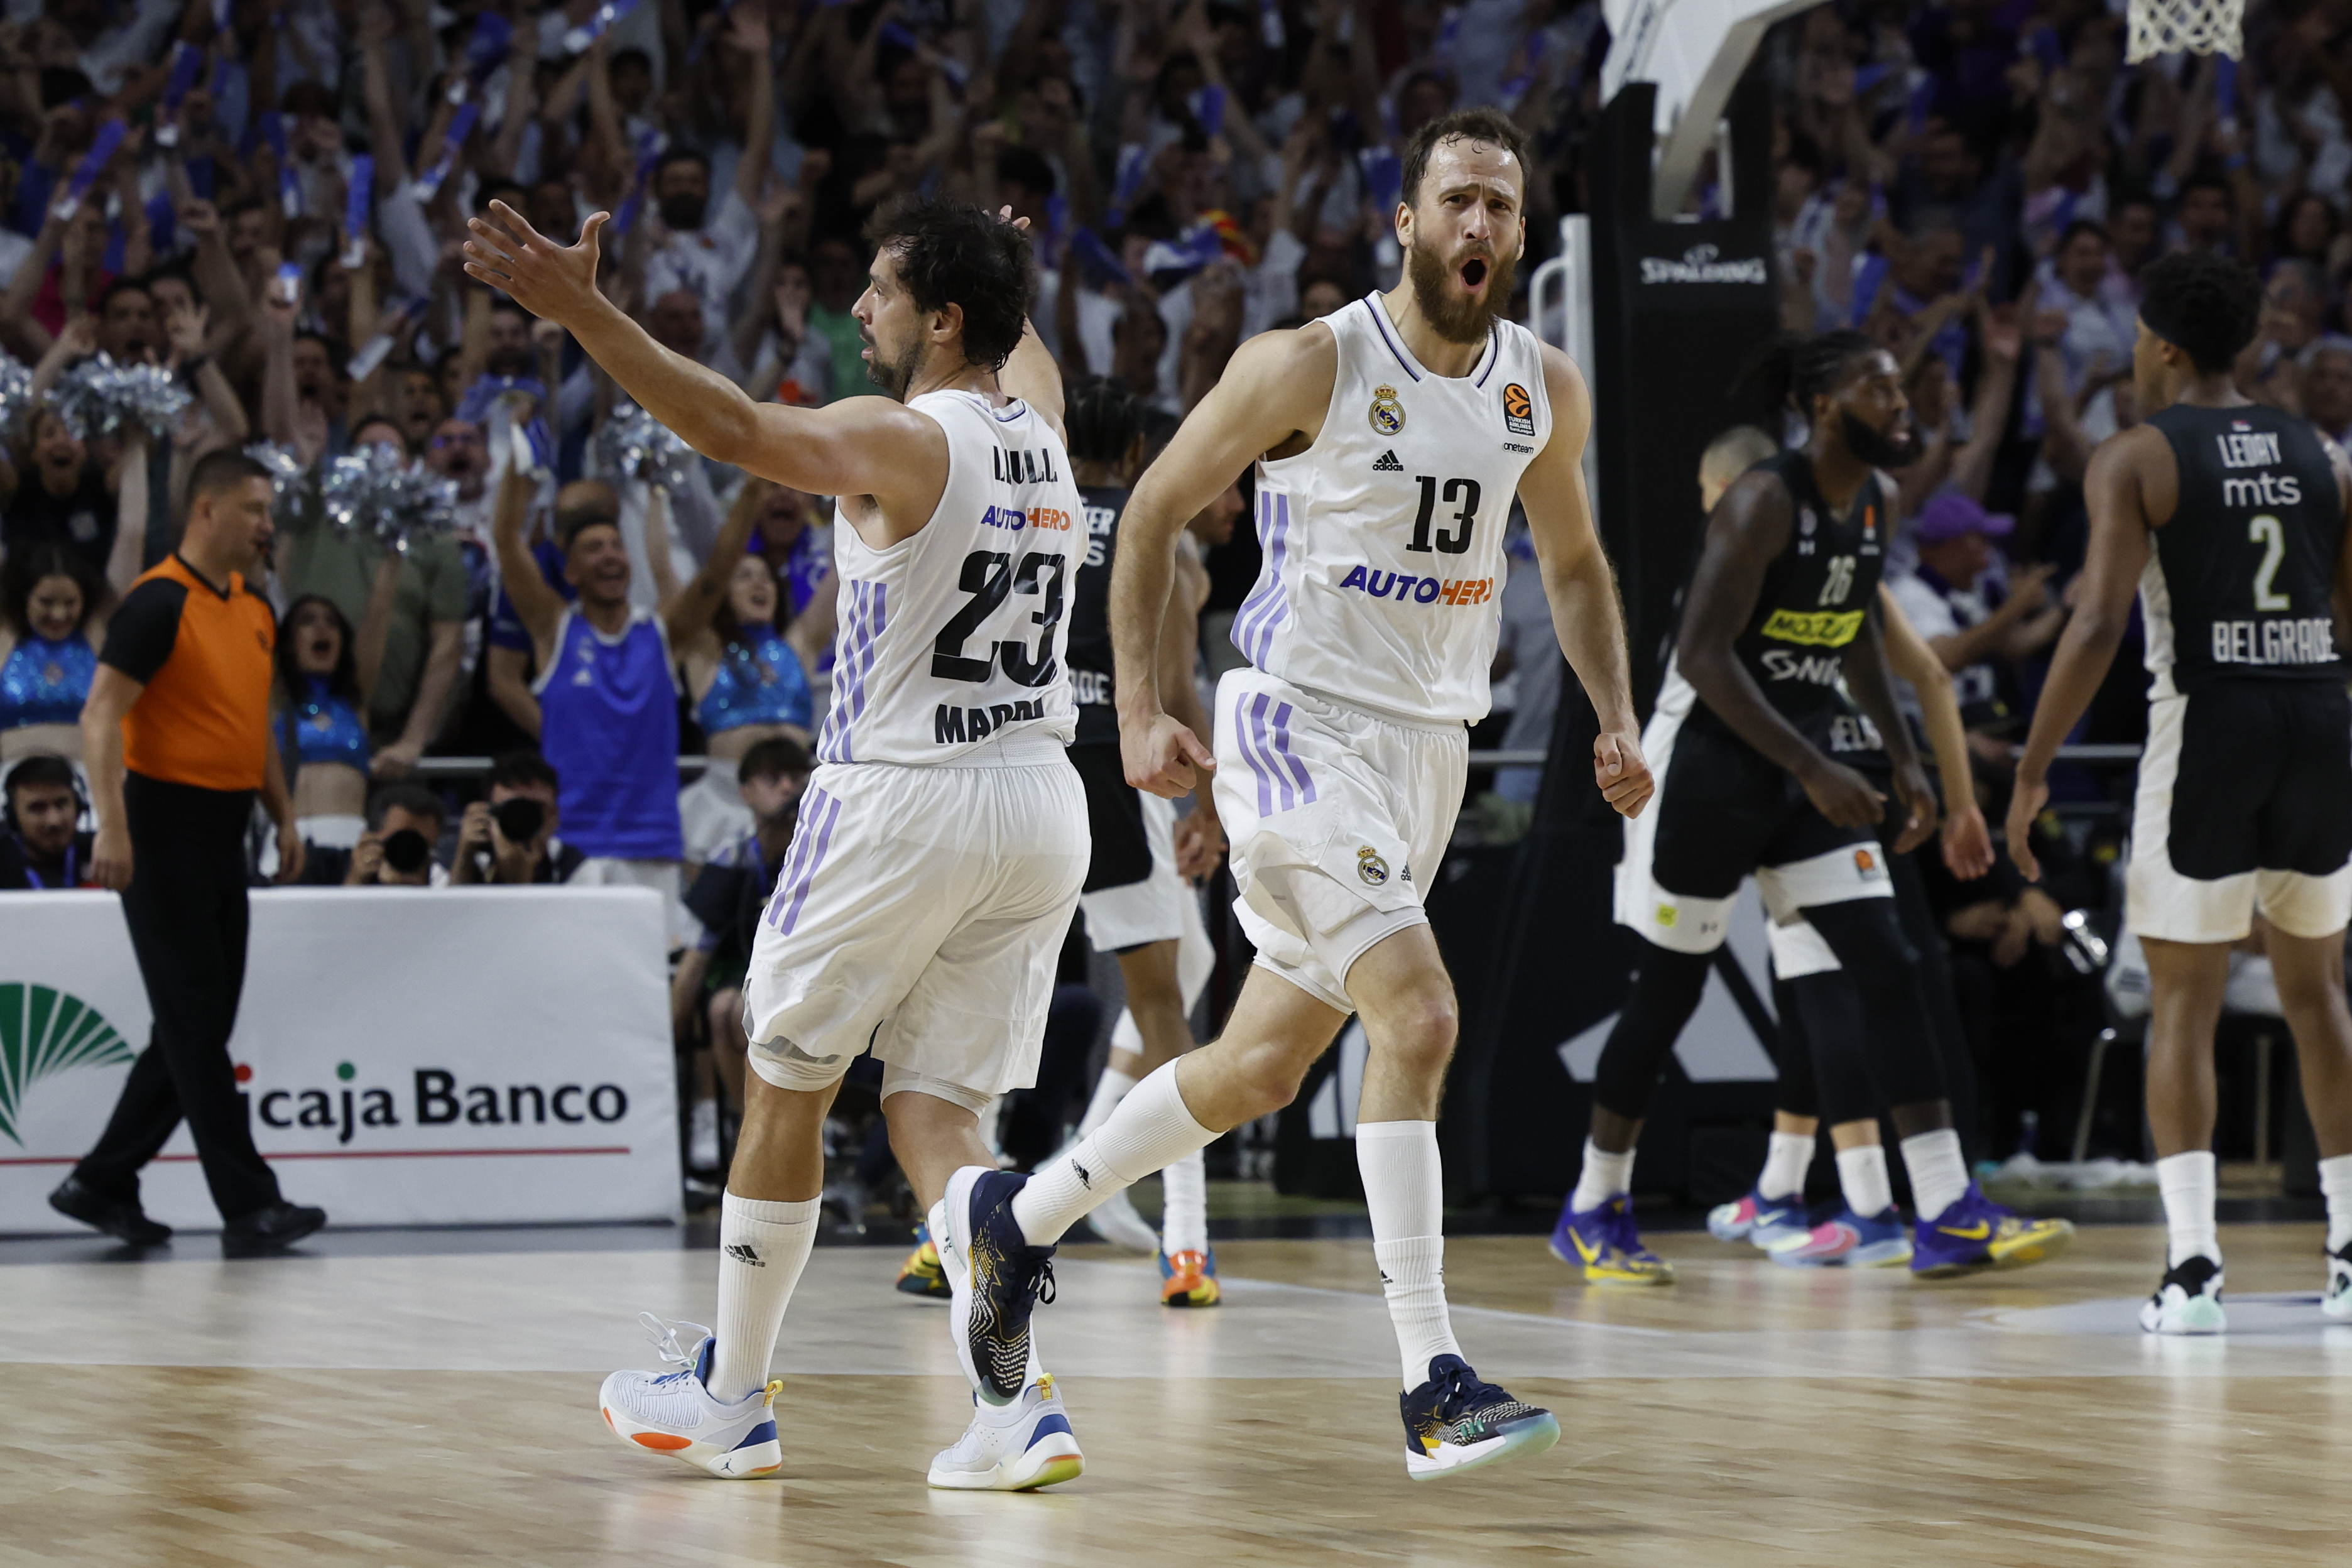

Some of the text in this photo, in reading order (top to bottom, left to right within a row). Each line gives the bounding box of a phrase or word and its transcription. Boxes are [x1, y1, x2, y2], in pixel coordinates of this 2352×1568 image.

[1508, 415, 1532, 425] TURKISH
[1509, 421, 1532, 430] AIRLINES
[1372, 462, 1404, 471] adidas
[2223, 471, 2302, 507] mts
[981, 505, 1071, 531] AUTOHERO
[1406, 476, 1481, 554] 13
[2249, 514, 2290, 612] 2
[931, 550, 1066, 687] 23
[234, 1062, 628, 1146] icaja Banco
